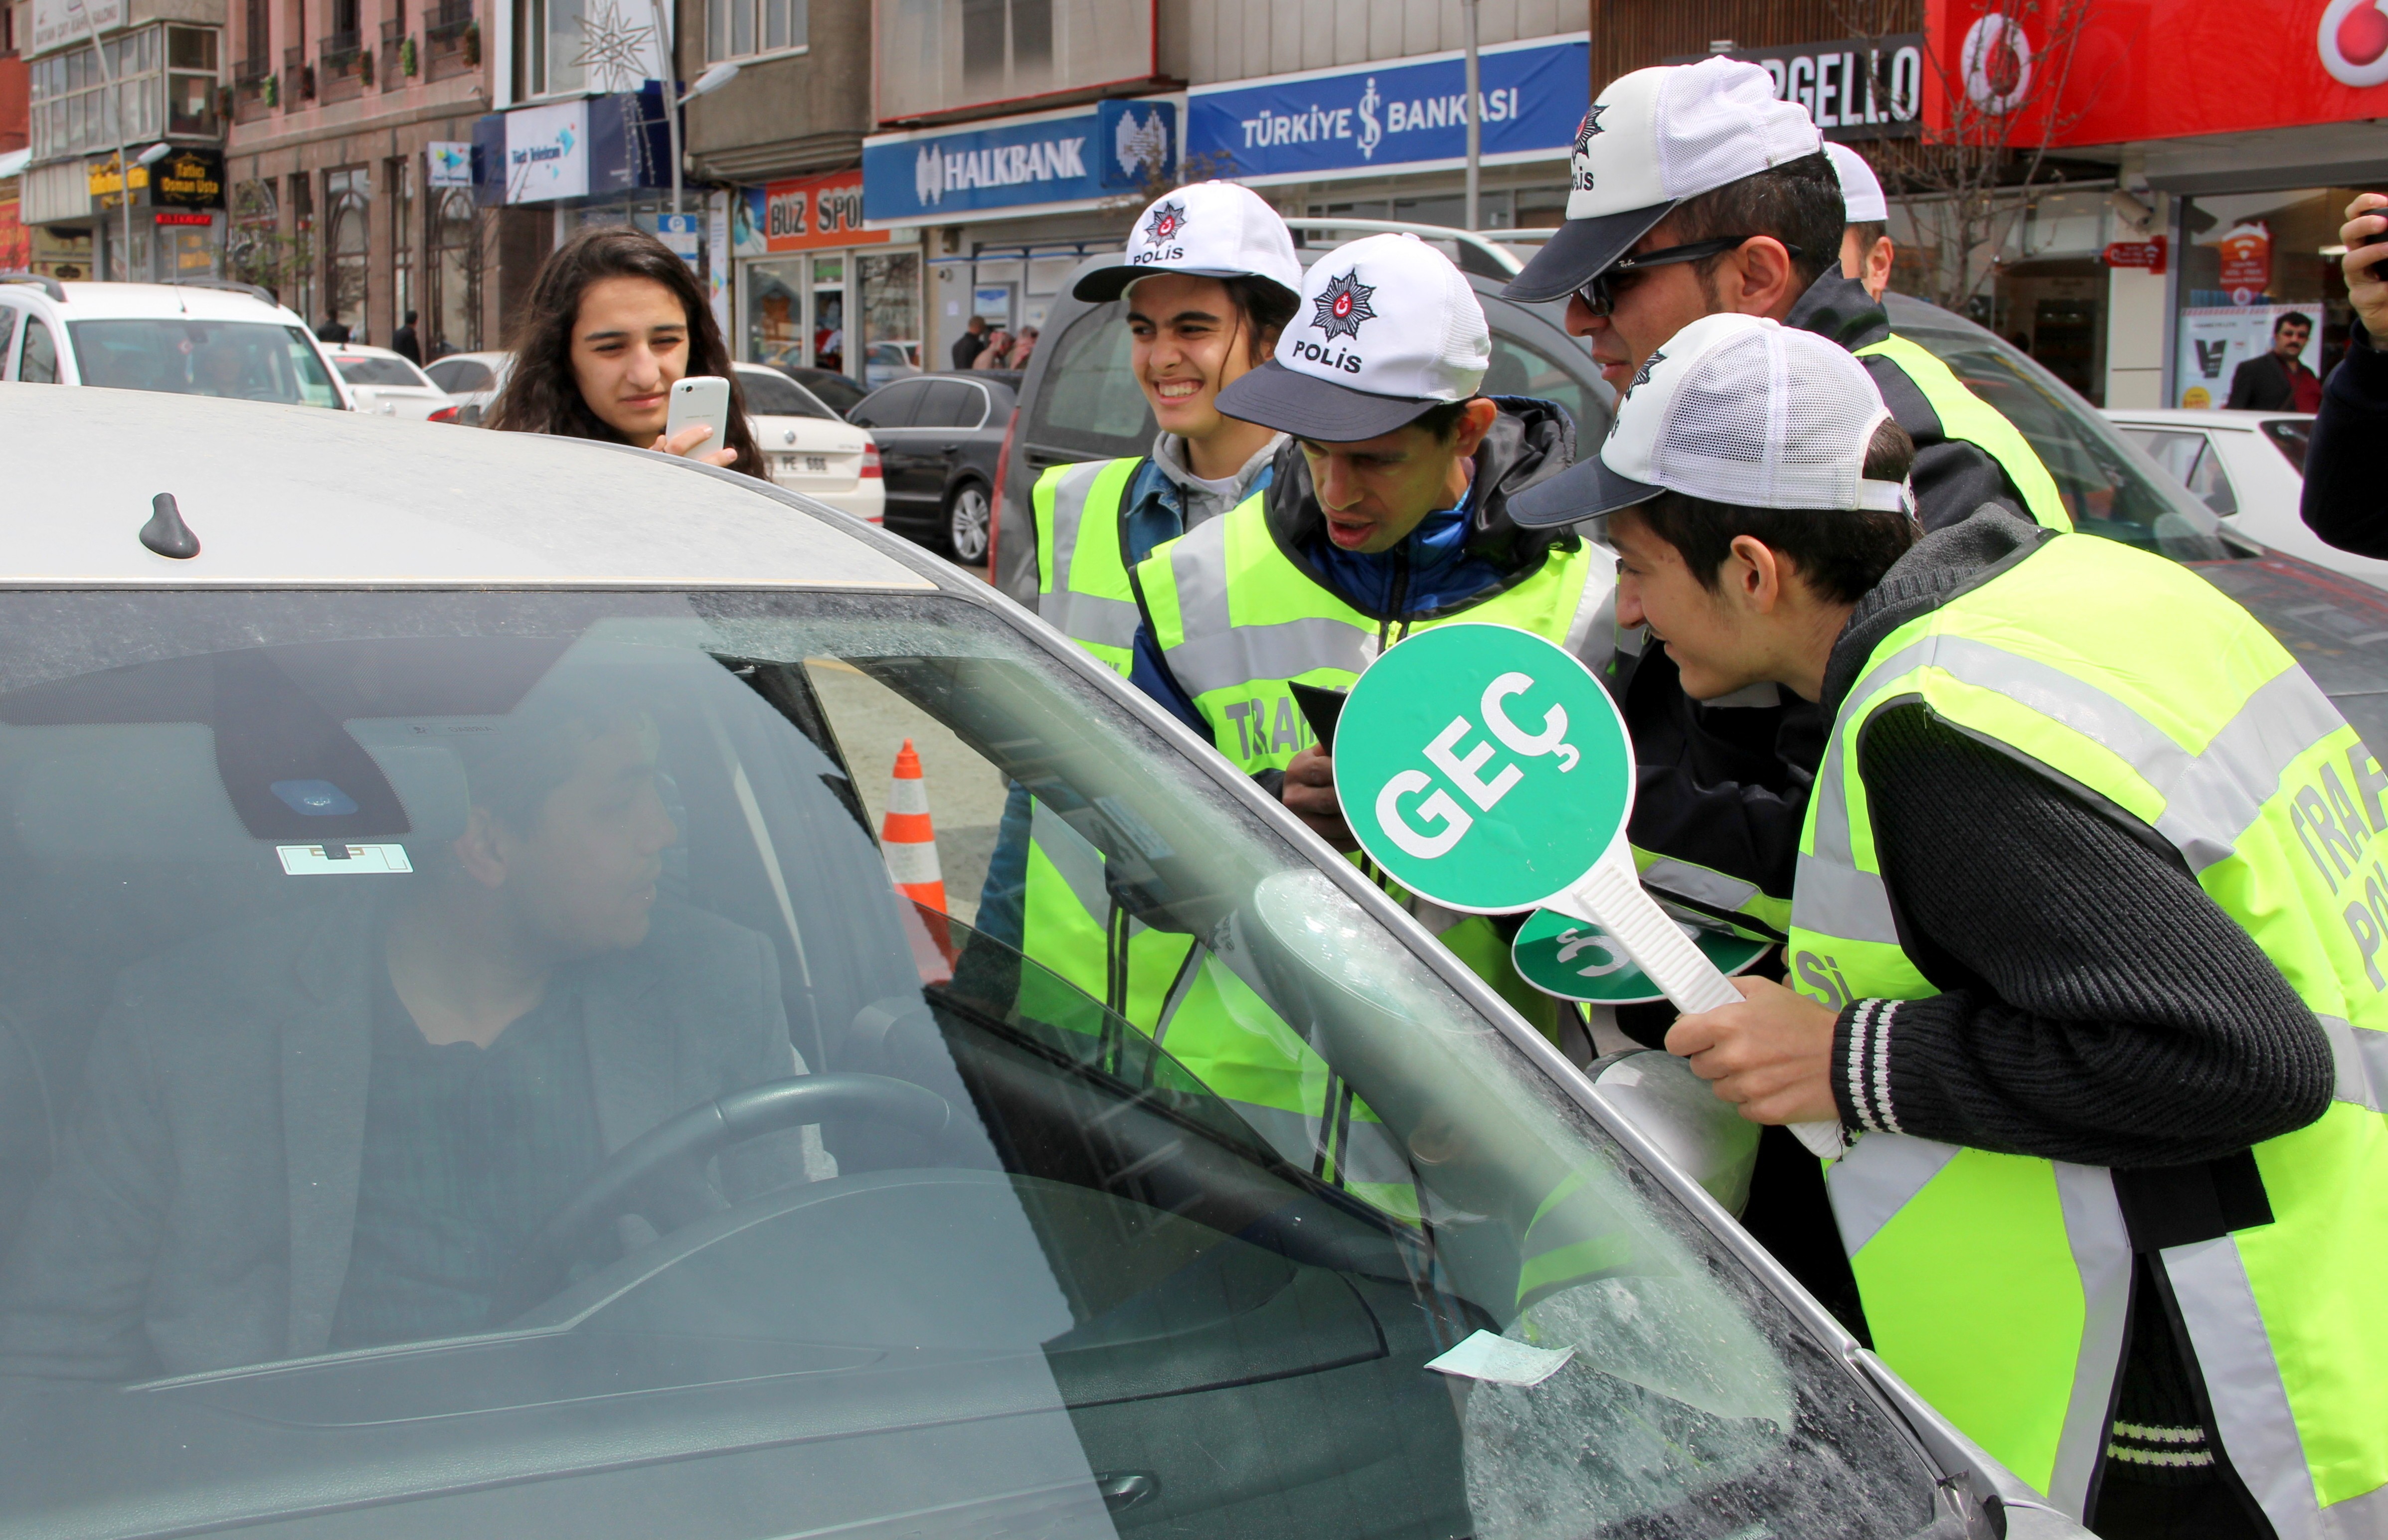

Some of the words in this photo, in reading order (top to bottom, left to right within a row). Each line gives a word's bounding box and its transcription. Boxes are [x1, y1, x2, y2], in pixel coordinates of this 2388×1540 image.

[1241, 104, 1353, 148] TÜRKİYE
[944, 137, 1087, 191] HALKBANK
[770, 193, 807, 238] BUZ
[1134, 245, 1184, 266] POLİS
[1292, 340, 1362, 374] POLİS
[1375, 672, 1580, 859] GEÇ
